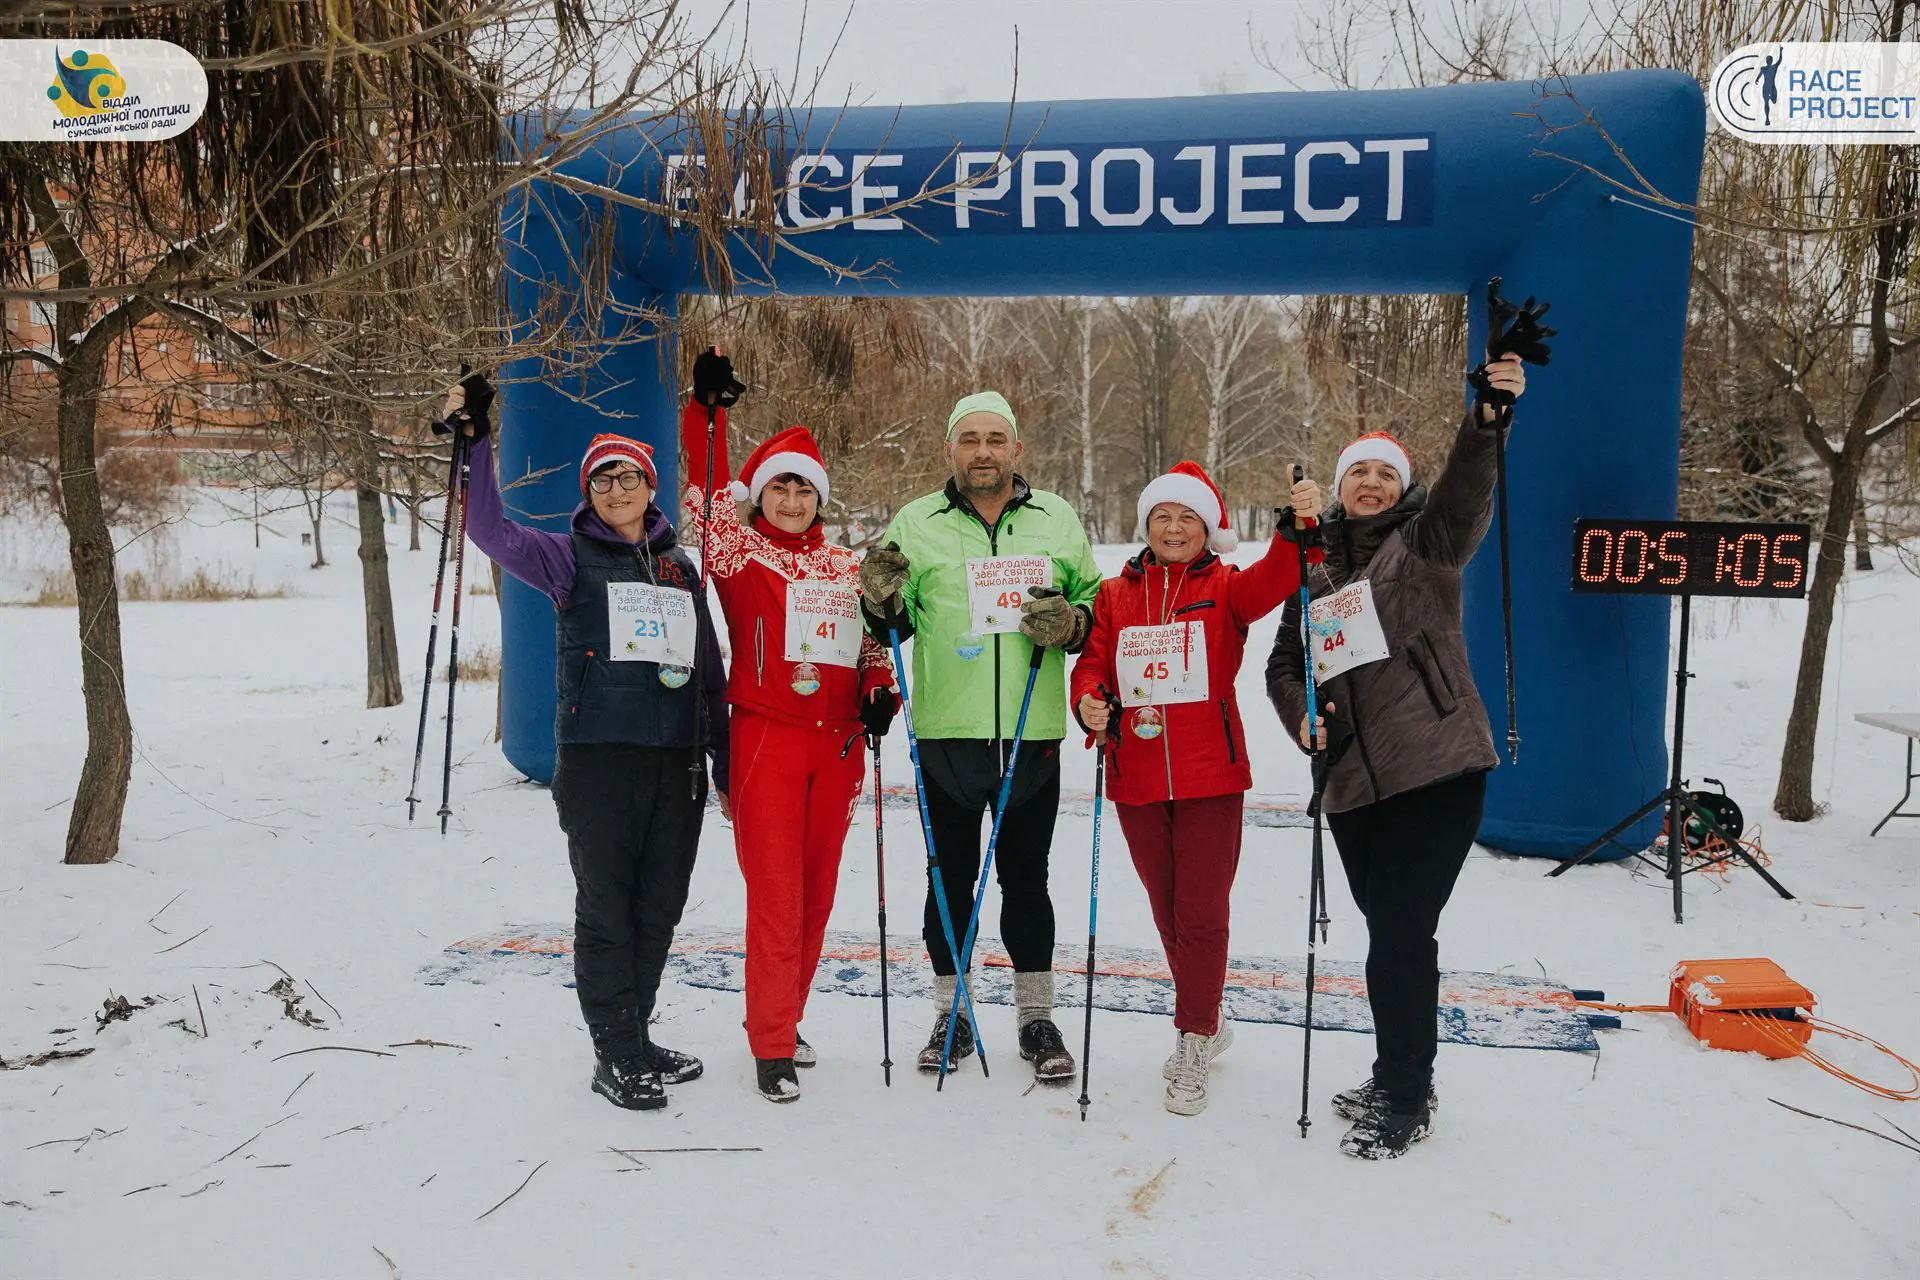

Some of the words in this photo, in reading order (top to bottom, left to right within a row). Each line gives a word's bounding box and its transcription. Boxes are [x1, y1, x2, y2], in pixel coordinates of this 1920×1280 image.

[955, 138, 1429, 229] PROJECT
[975, 570, 1000, 580] ЗАБІГ
[1003, 568, 1044, 577] СВЯТОГО
[975, 577, 1020, 588] МИКОЛАЯ
[1024, 577, 1044, 585] 2023
[795, 596, 820, 605] ЗАБІГ
[996, 591, 1022, 609] 49
[666, 608, 687, 618] 2023
[794, 605, 839, 616] МИКОЛАЯ
[841, 609, 857, 620] 2023
[1343, 604, 1363, 620] 2023
[634, 619, 668, 639] 231
[816, 621, 836, 640] 41
[1323, 630, 1345, 652] 44
[1122, 647, 1168, 658] МИКОЛАЯ
[1143, 661, 1169, 680] 45
